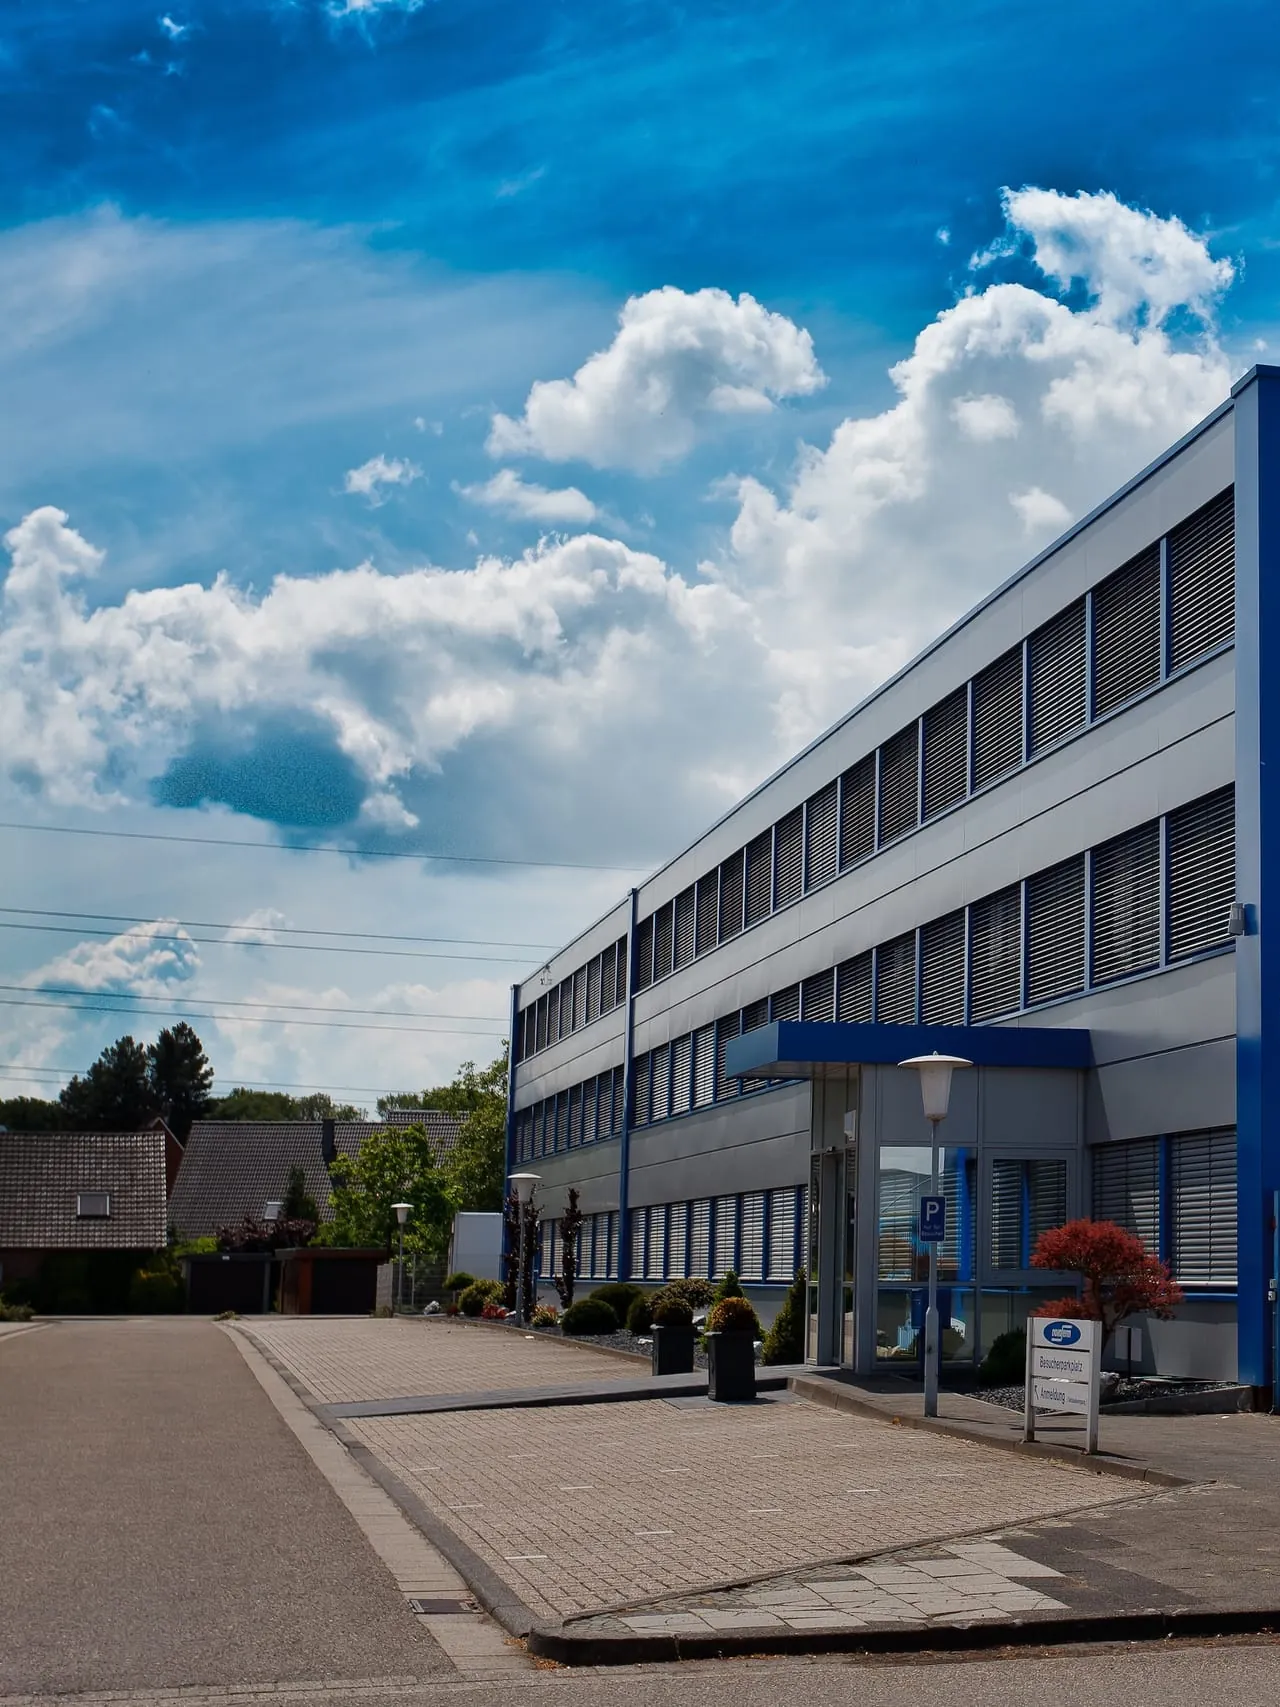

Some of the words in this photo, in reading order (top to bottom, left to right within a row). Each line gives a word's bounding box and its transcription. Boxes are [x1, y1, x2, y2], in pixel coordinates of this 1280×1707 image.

[926, 1201, 939, 1221] P
[1039, 1356, 1083, 1373] Besucherparkplatz
[1040, 1386, 1065, 1405] Anmeldung
